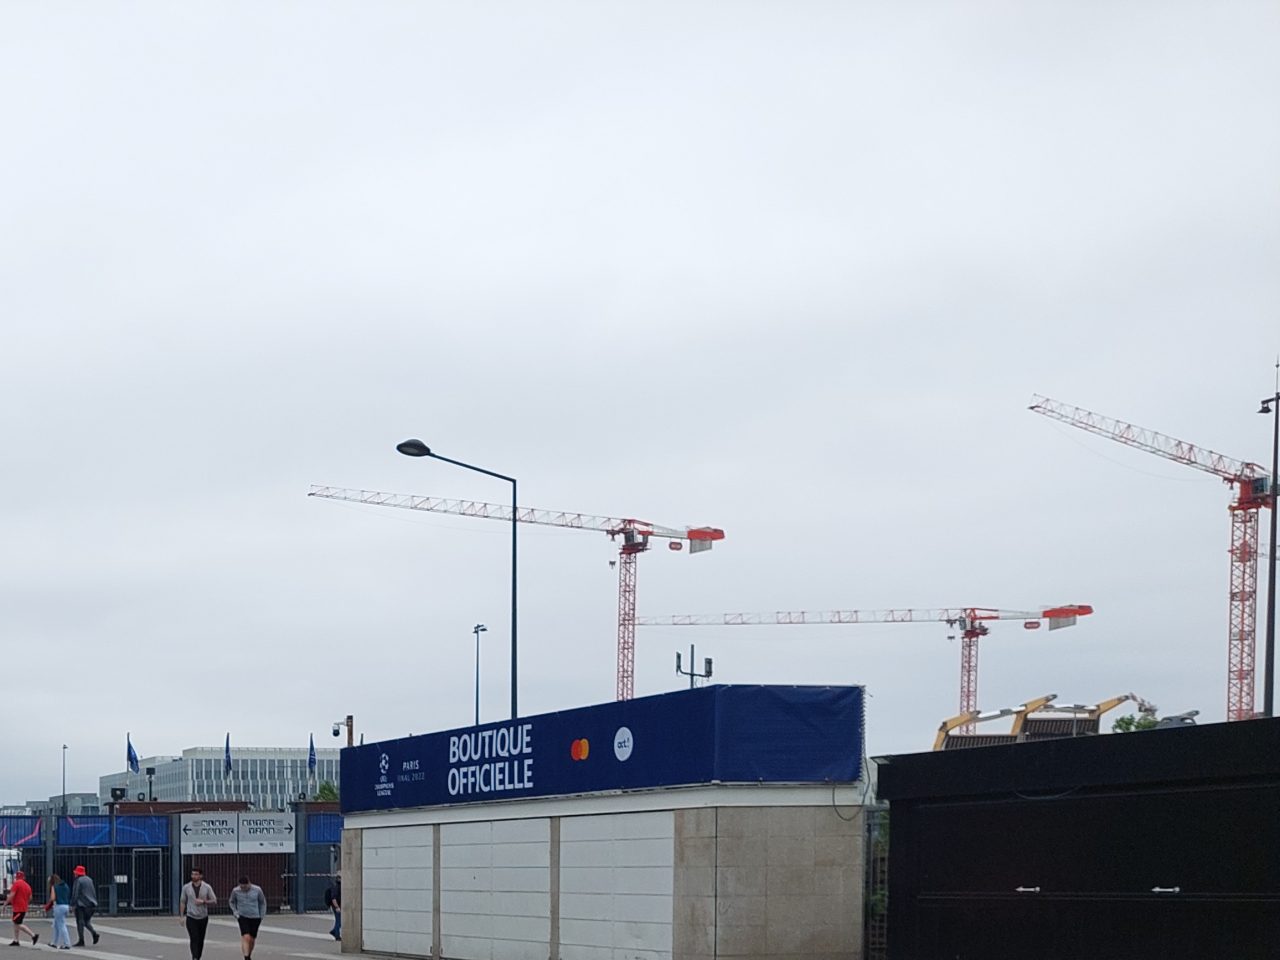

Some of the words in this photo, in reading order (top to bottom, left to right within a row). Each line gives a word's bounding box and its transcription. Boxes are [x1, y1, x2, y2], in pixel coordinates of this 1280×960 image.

[449, 724, 533, 763] BOUTIQUE
[402, 759, 420, 771] PARIS
[447, 759, 534, 796] OFFICIELLE
